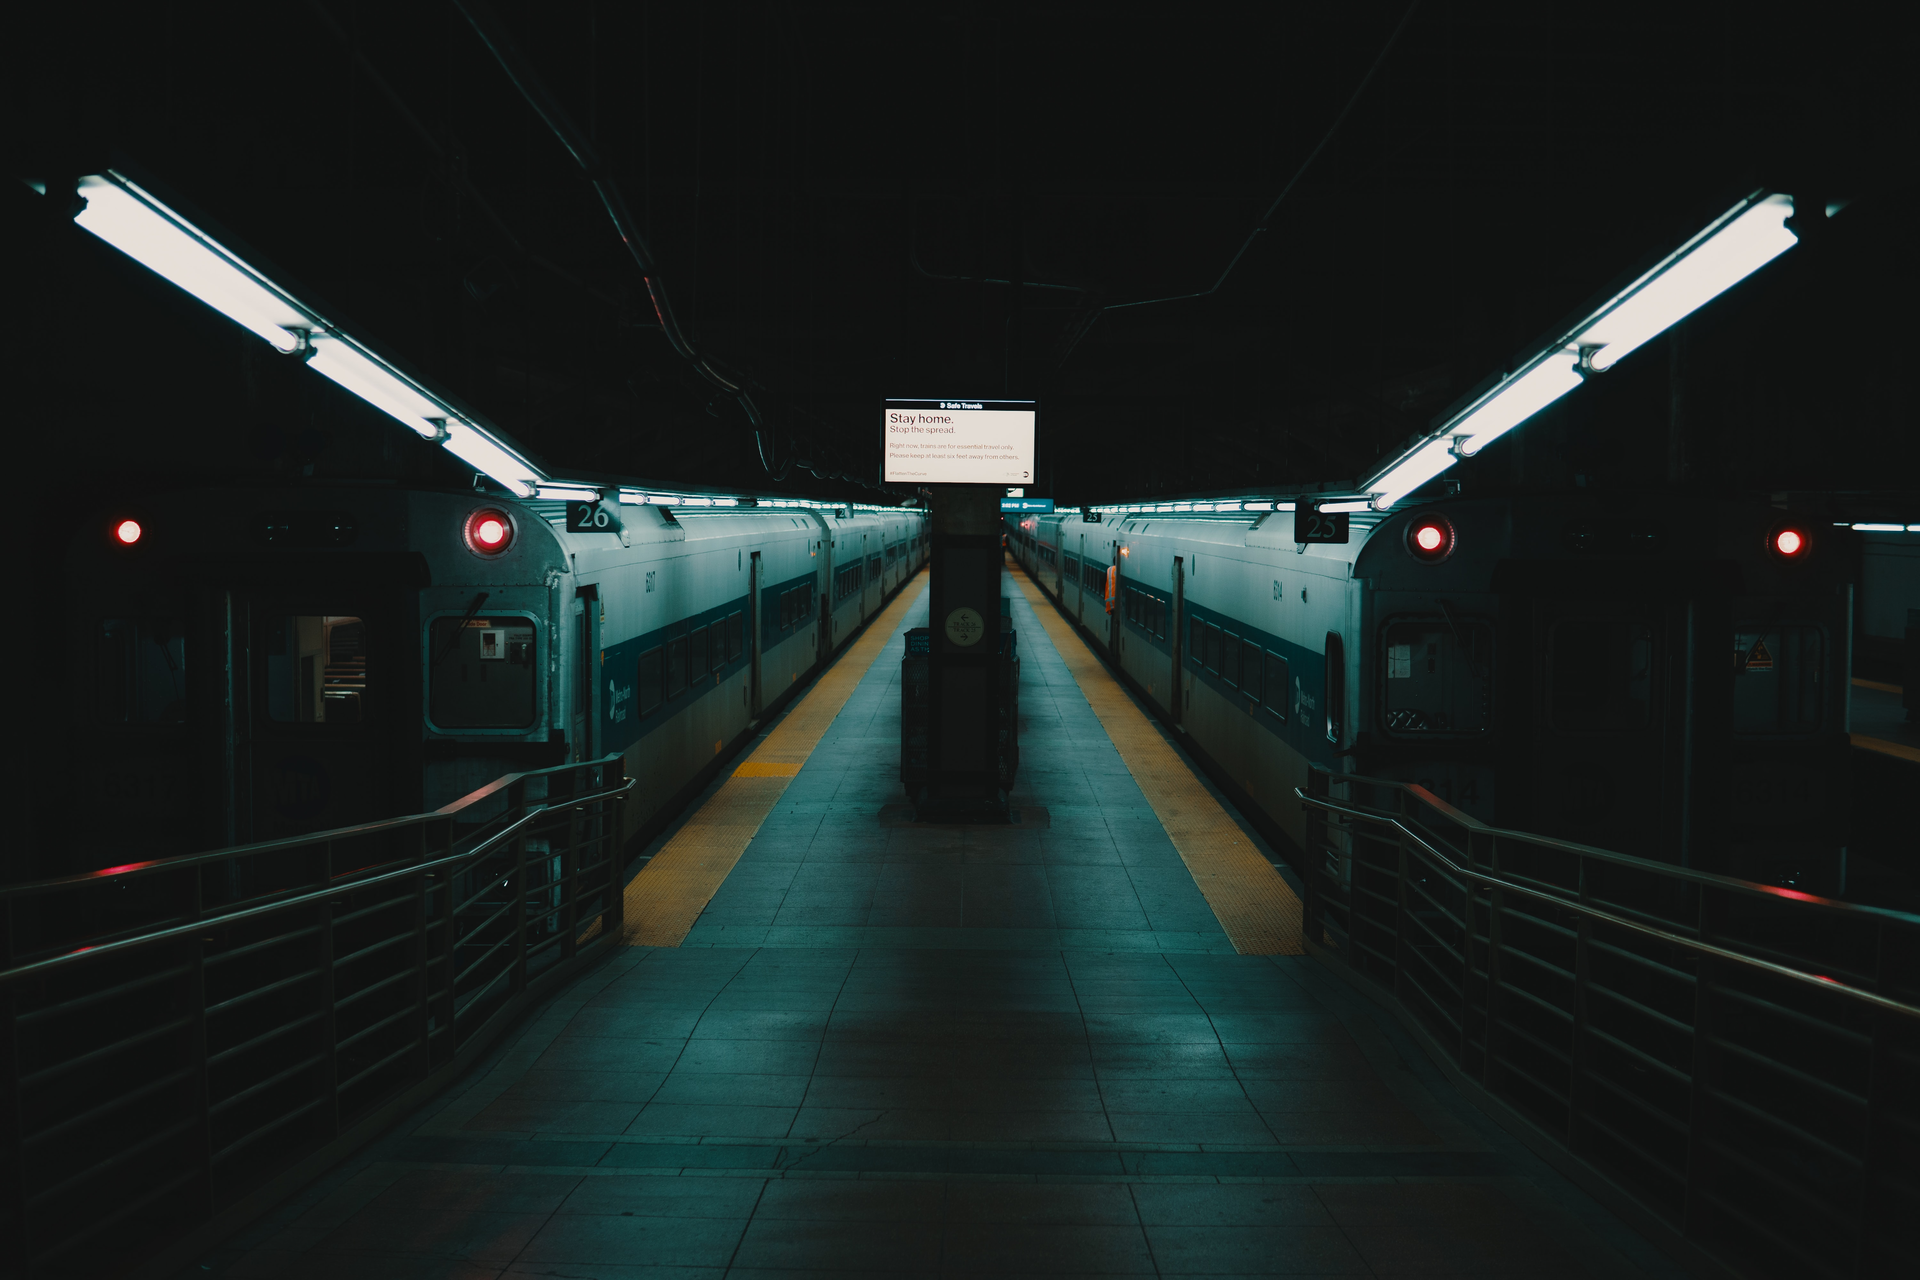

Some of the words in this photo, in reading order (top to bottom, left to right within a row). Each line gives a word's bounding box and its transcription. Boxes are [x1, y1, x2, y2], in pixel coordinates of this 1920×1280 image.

[890, 412, 916, 425] Stay
[918, 413, 954, 424] home.
[889, 425, 910, 434] Stop
[925, 426, 956, 435] spread.
[578, 504, 609, 528] 26
[1087, 513, 1098, 522] 25
[1307, 515, 1337, 539] 25
